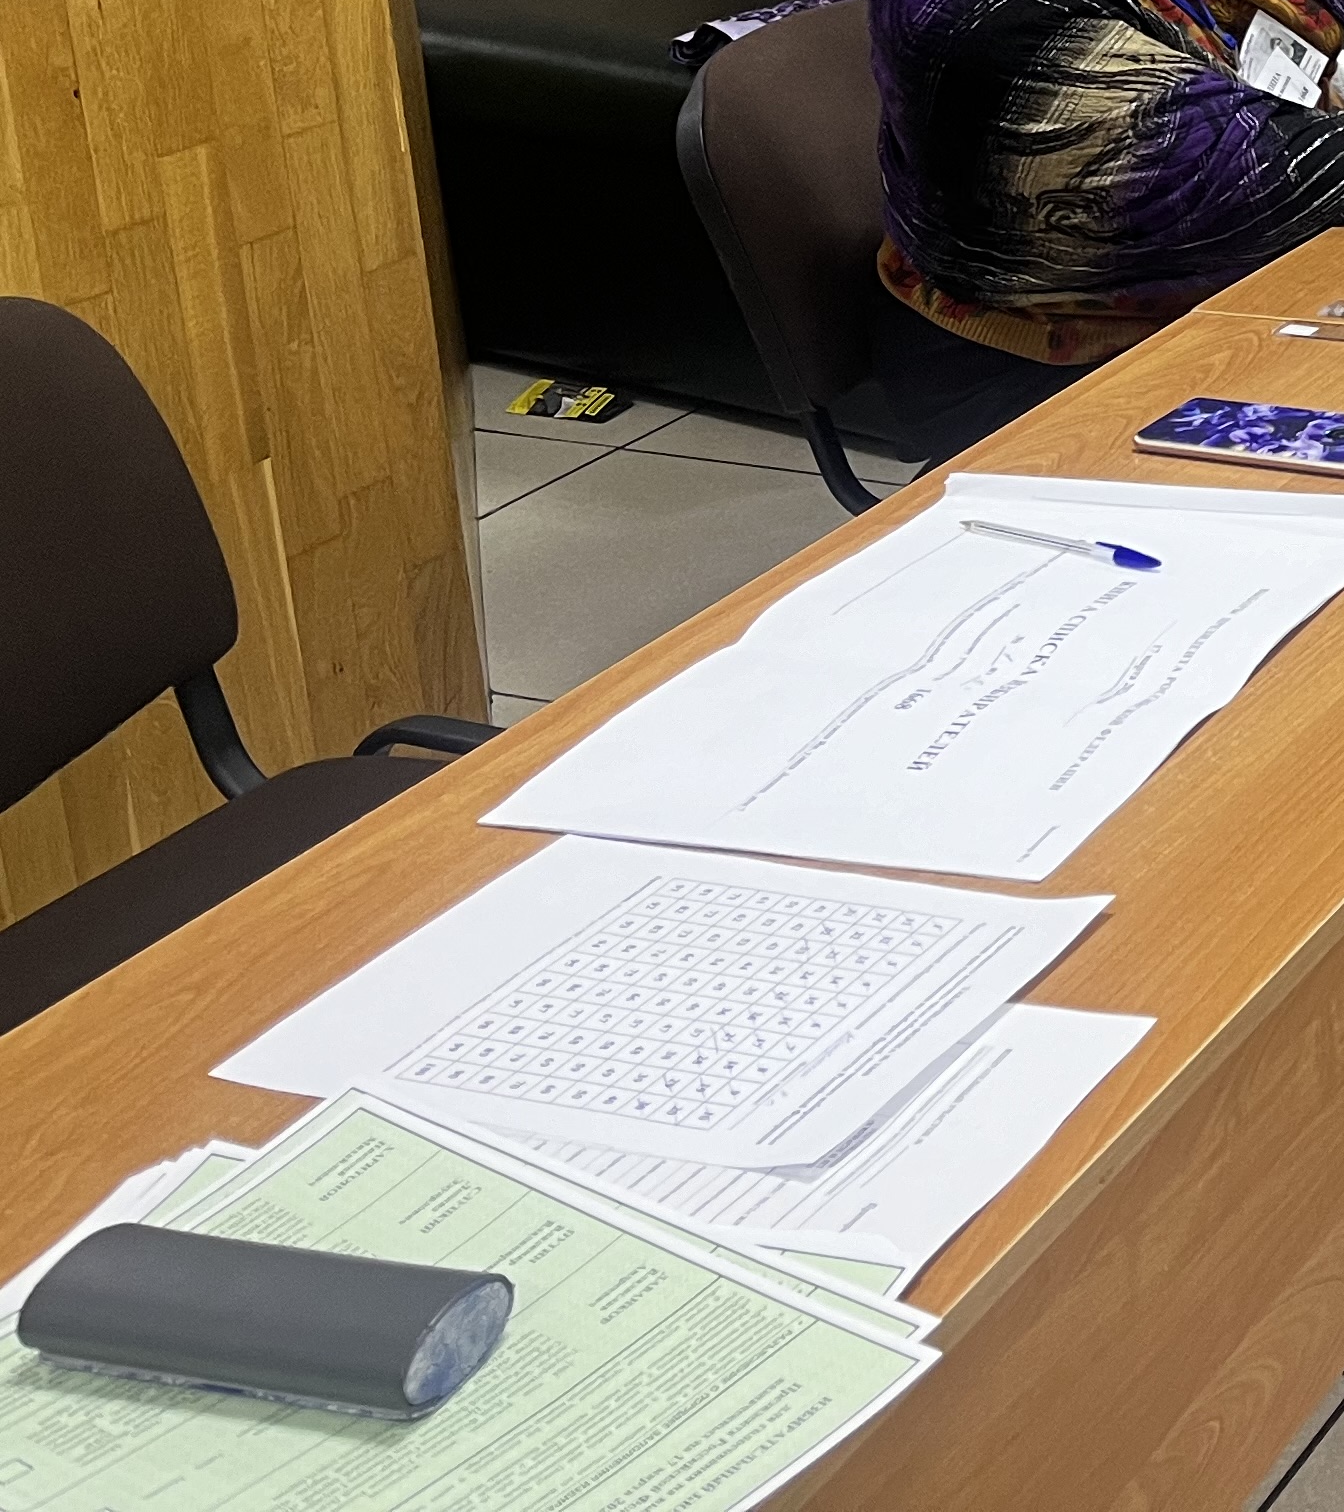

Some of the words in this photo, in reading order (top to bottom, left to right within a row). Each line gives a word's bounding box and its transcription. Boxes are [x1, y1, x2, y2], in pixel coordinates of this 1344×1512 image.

[1081, 581, 1138, 613] КНИГА
[1021, 614, 1087, 676] СПИСКА
[894, 688, 932, 710] 1668
[906, 680, 1028, 771] ИЗБИРАТЕЛЕЙ
[701, 1395, 833, 1494] ИЗБИРАТЕЛЬНЫЙ
